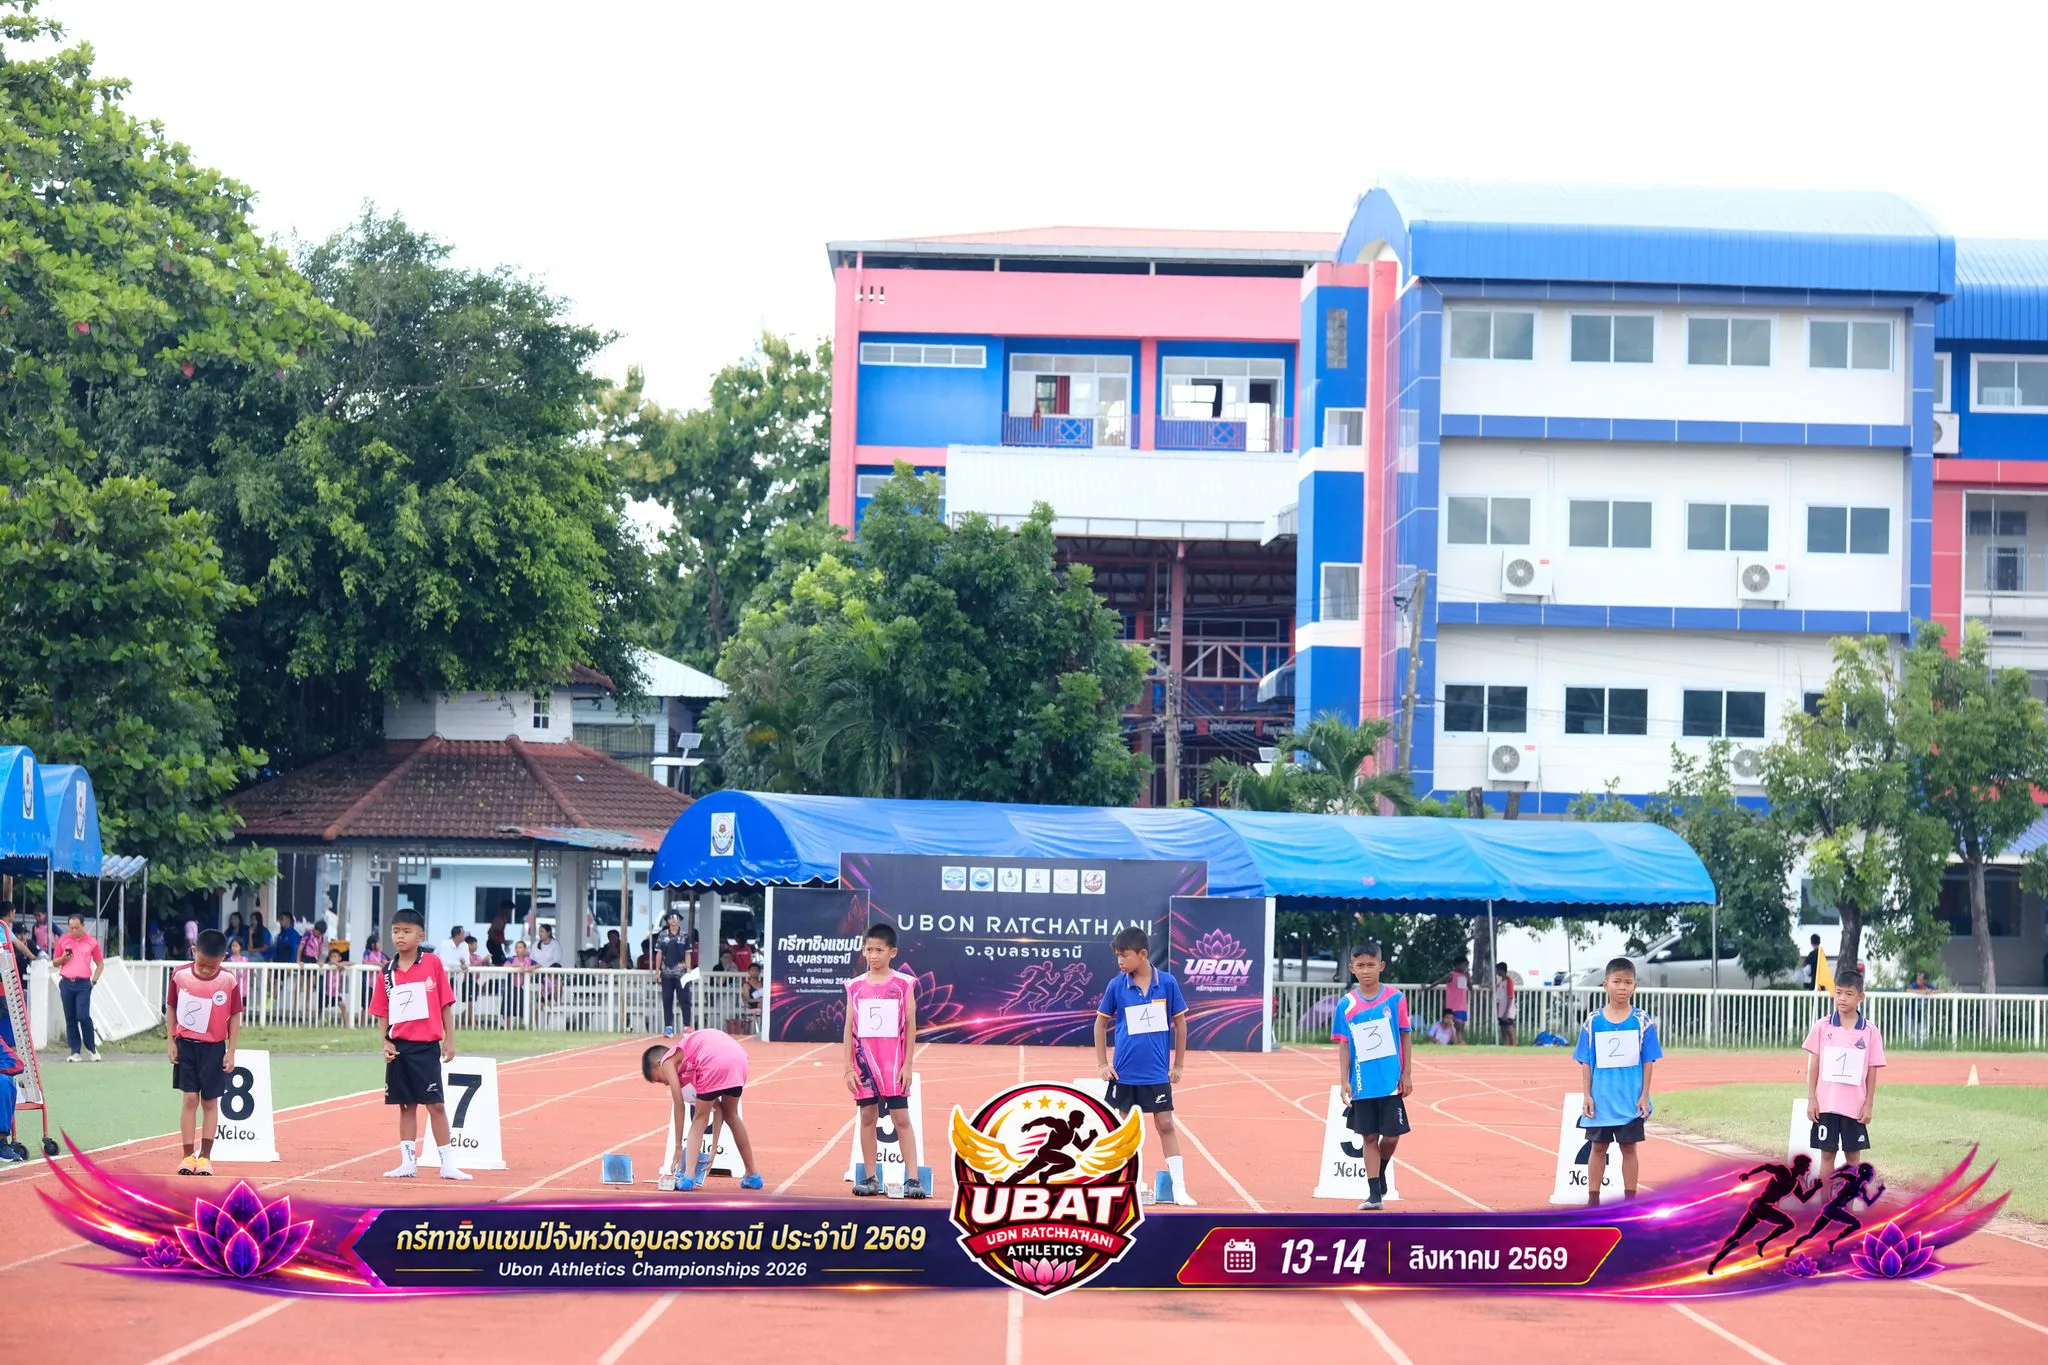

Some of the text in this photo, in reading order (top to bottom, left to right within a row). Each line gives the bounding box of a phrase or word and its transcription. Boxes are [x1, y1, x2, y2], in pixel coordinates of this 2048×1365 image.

[898, 914, 974, 932] UBON
[965, 945, 1082, 960] จ.อุบลราชธานี
[1184, 959, 1253, 975] UBON
[1185, 976, 1249, 984] ATHLETICS
[396, 990, 413, 1014] 7
[184, 1000, 202, 1026] 8
[869, 1007, 882, 1030] 5
[1139, 1008, 1156, 1028] 4
[1363, 1026, 1382, 1050] 3
[1608, 1037, 1625, 1057] 2
[1832, 1053, 1852, 1077] 1
[220, 1066, 255, 1120] 8
[448, 1073, 482, 1128] 7
[215, 1125, 256, 1140] Nelco
[449, 1131, 479, 1149] elco
[876, 1148, 904, 1163] elco
[1334, 1162, 1366, 1177] Nelc
